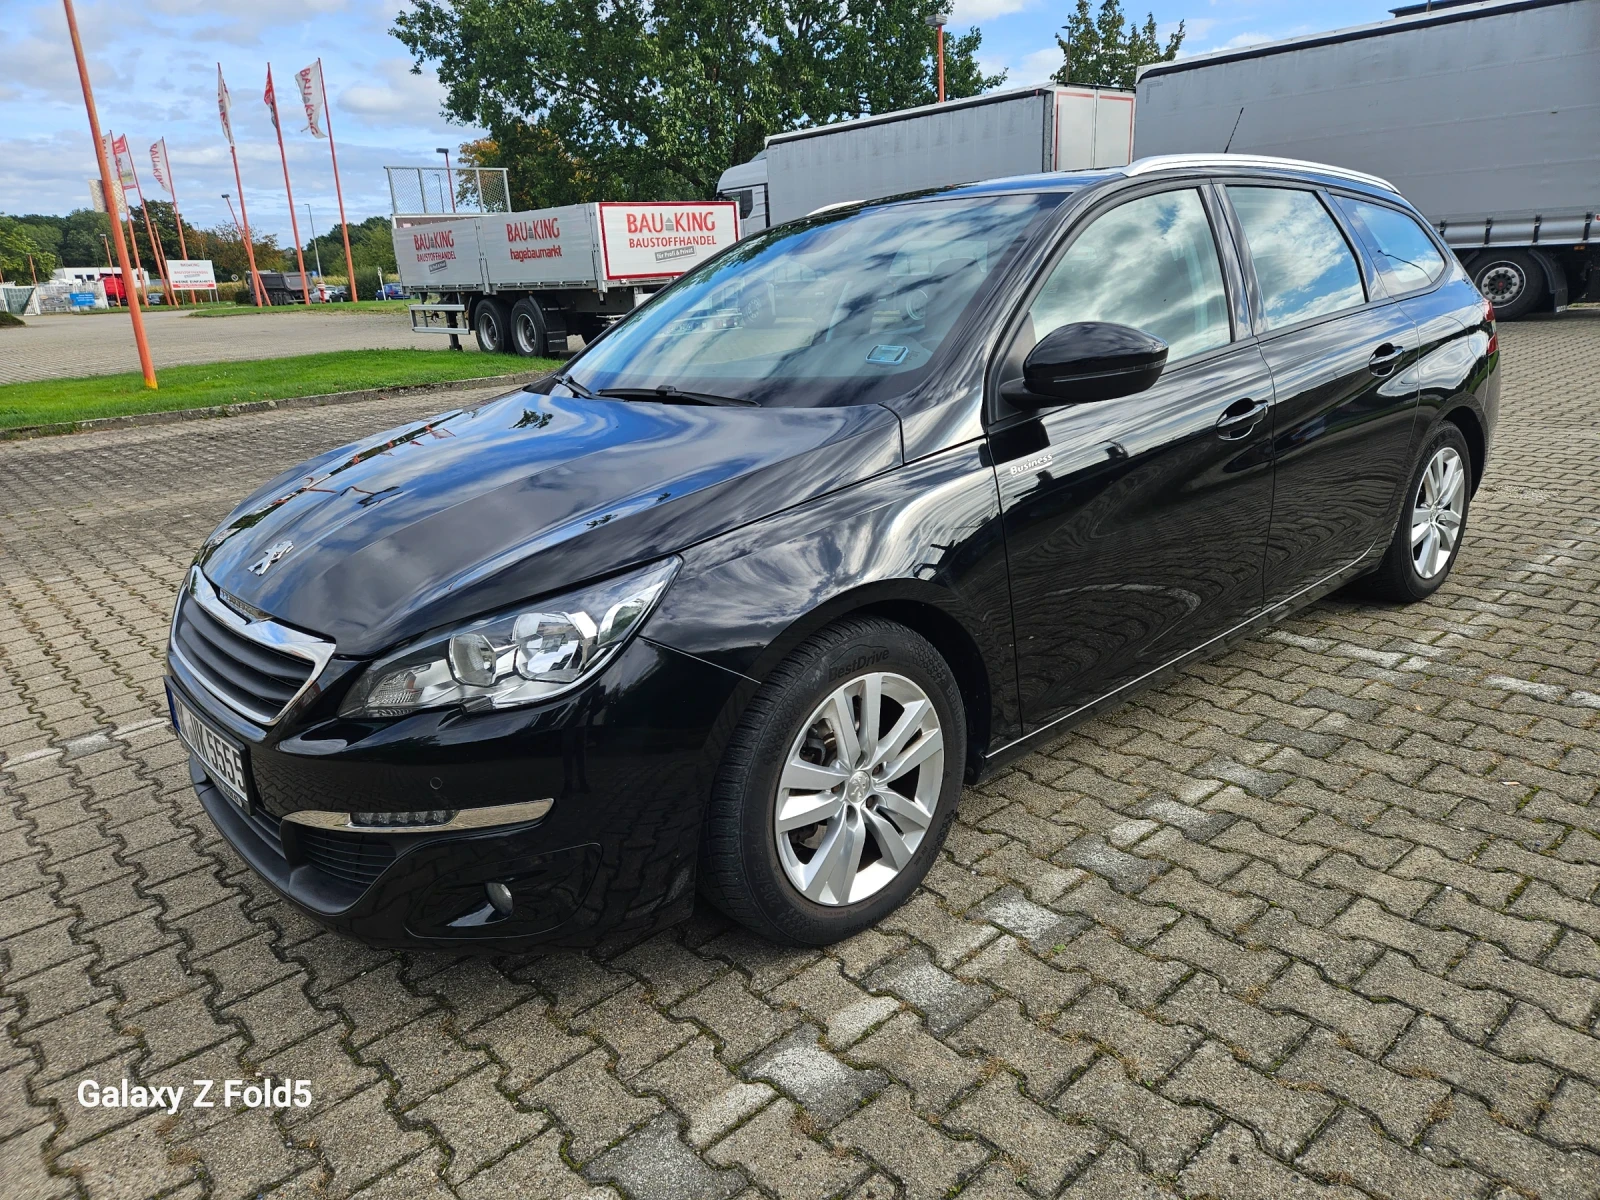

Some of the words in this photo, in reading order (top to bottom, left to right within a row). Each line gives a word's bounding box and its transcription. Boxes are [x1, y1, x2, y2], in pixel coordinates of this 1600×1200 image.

[629, 235, 717, 249] BAUSTOFFHANDEL
[416, 251, 457, 263] BAUSTOFFHANDEL
[510, 244, 563, 263] hagebaumarkt
[1010, 453, 1053, 475] Business
[828, 648, 890, 681] BestDrive
[205, 728, 247, 794] 5555
